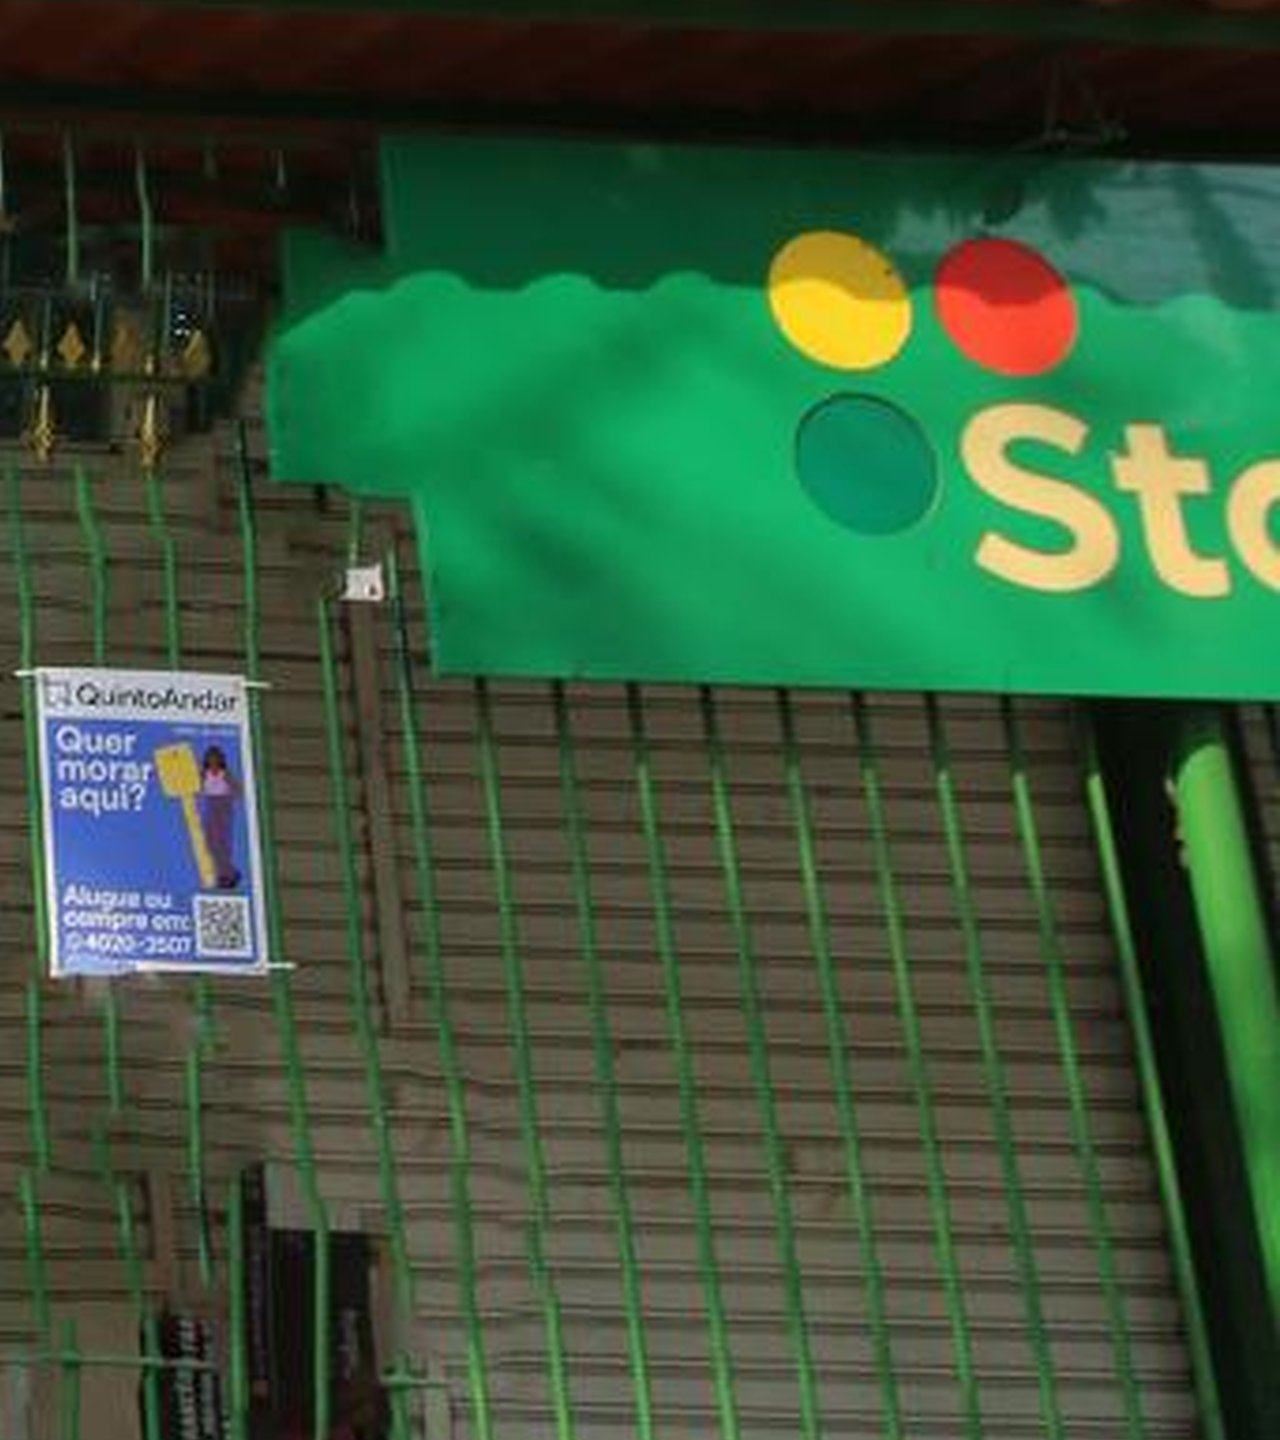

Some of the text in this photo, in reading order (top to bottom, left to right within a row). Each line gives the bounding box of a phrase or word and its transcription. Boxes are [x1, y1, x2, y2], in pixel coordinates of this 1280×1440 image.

[76, 682, 237, 711] QuintoAndar
[56, 725, 136, 755] Quer
[58, 760, 153, 781] morar
[60, 783, 145, 819] aqui?
[63, 884, 141, 912] Alugue
